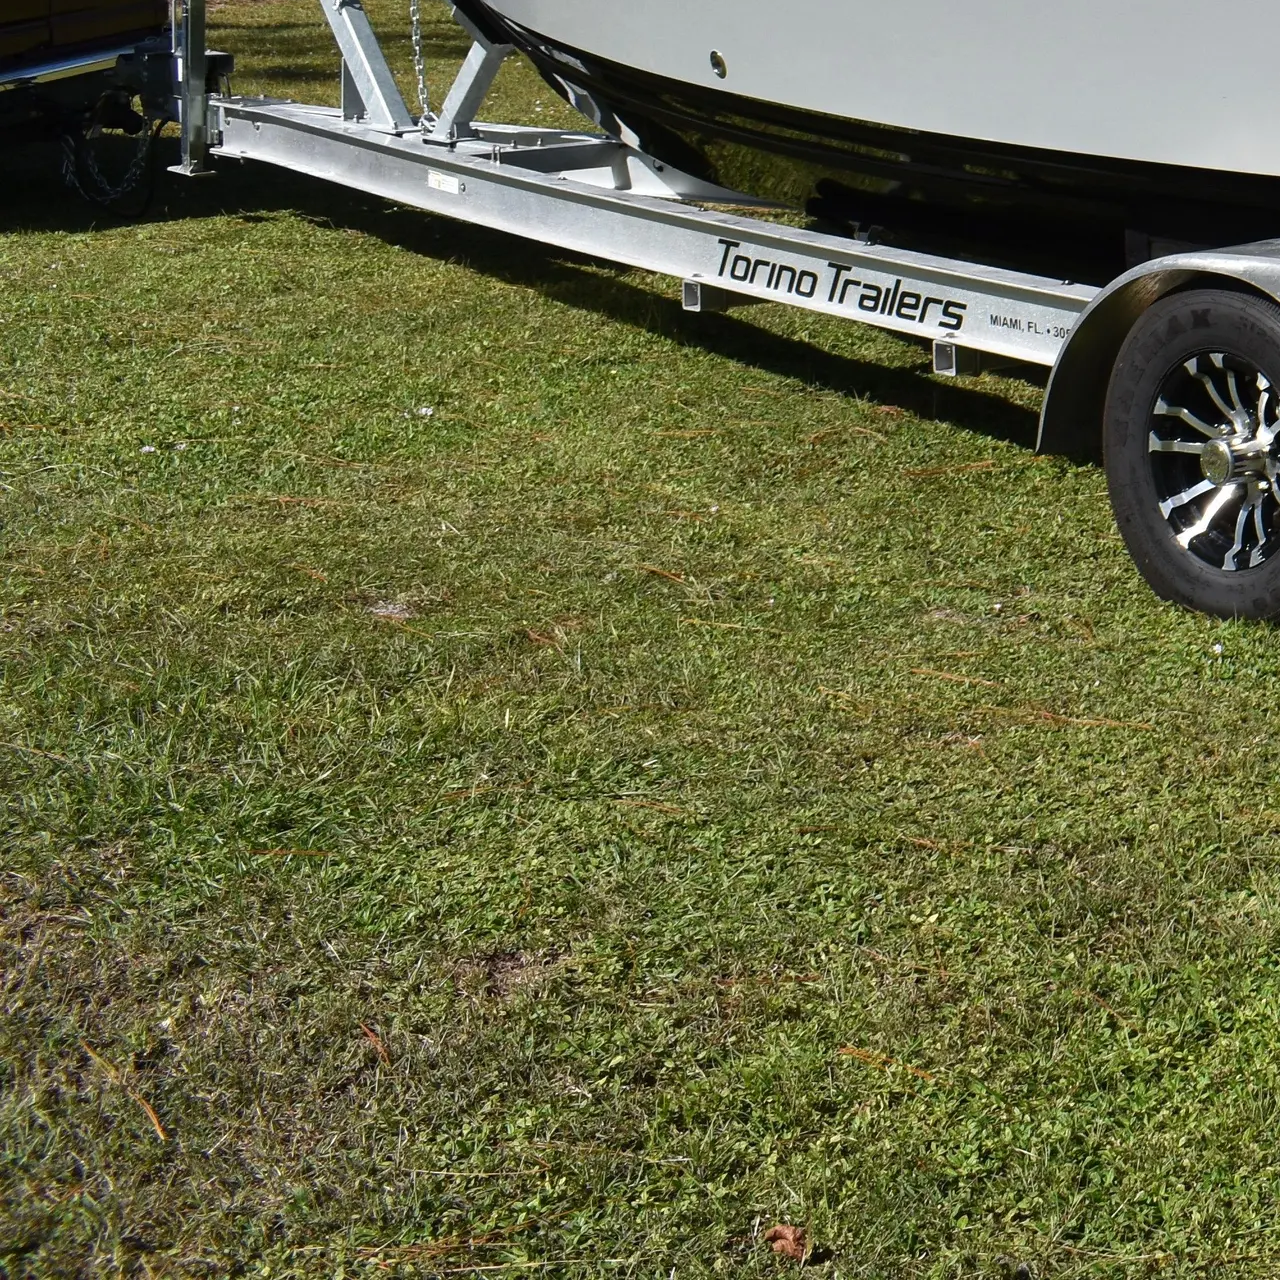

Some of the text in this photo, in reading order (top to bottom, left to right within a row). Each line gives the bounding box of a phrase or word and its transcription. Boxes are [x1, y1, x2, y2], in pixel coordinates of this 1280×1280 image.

[717, 238, 967, 331] Torino Trailers
[989, 313, 1024, 333] MIAMI,
